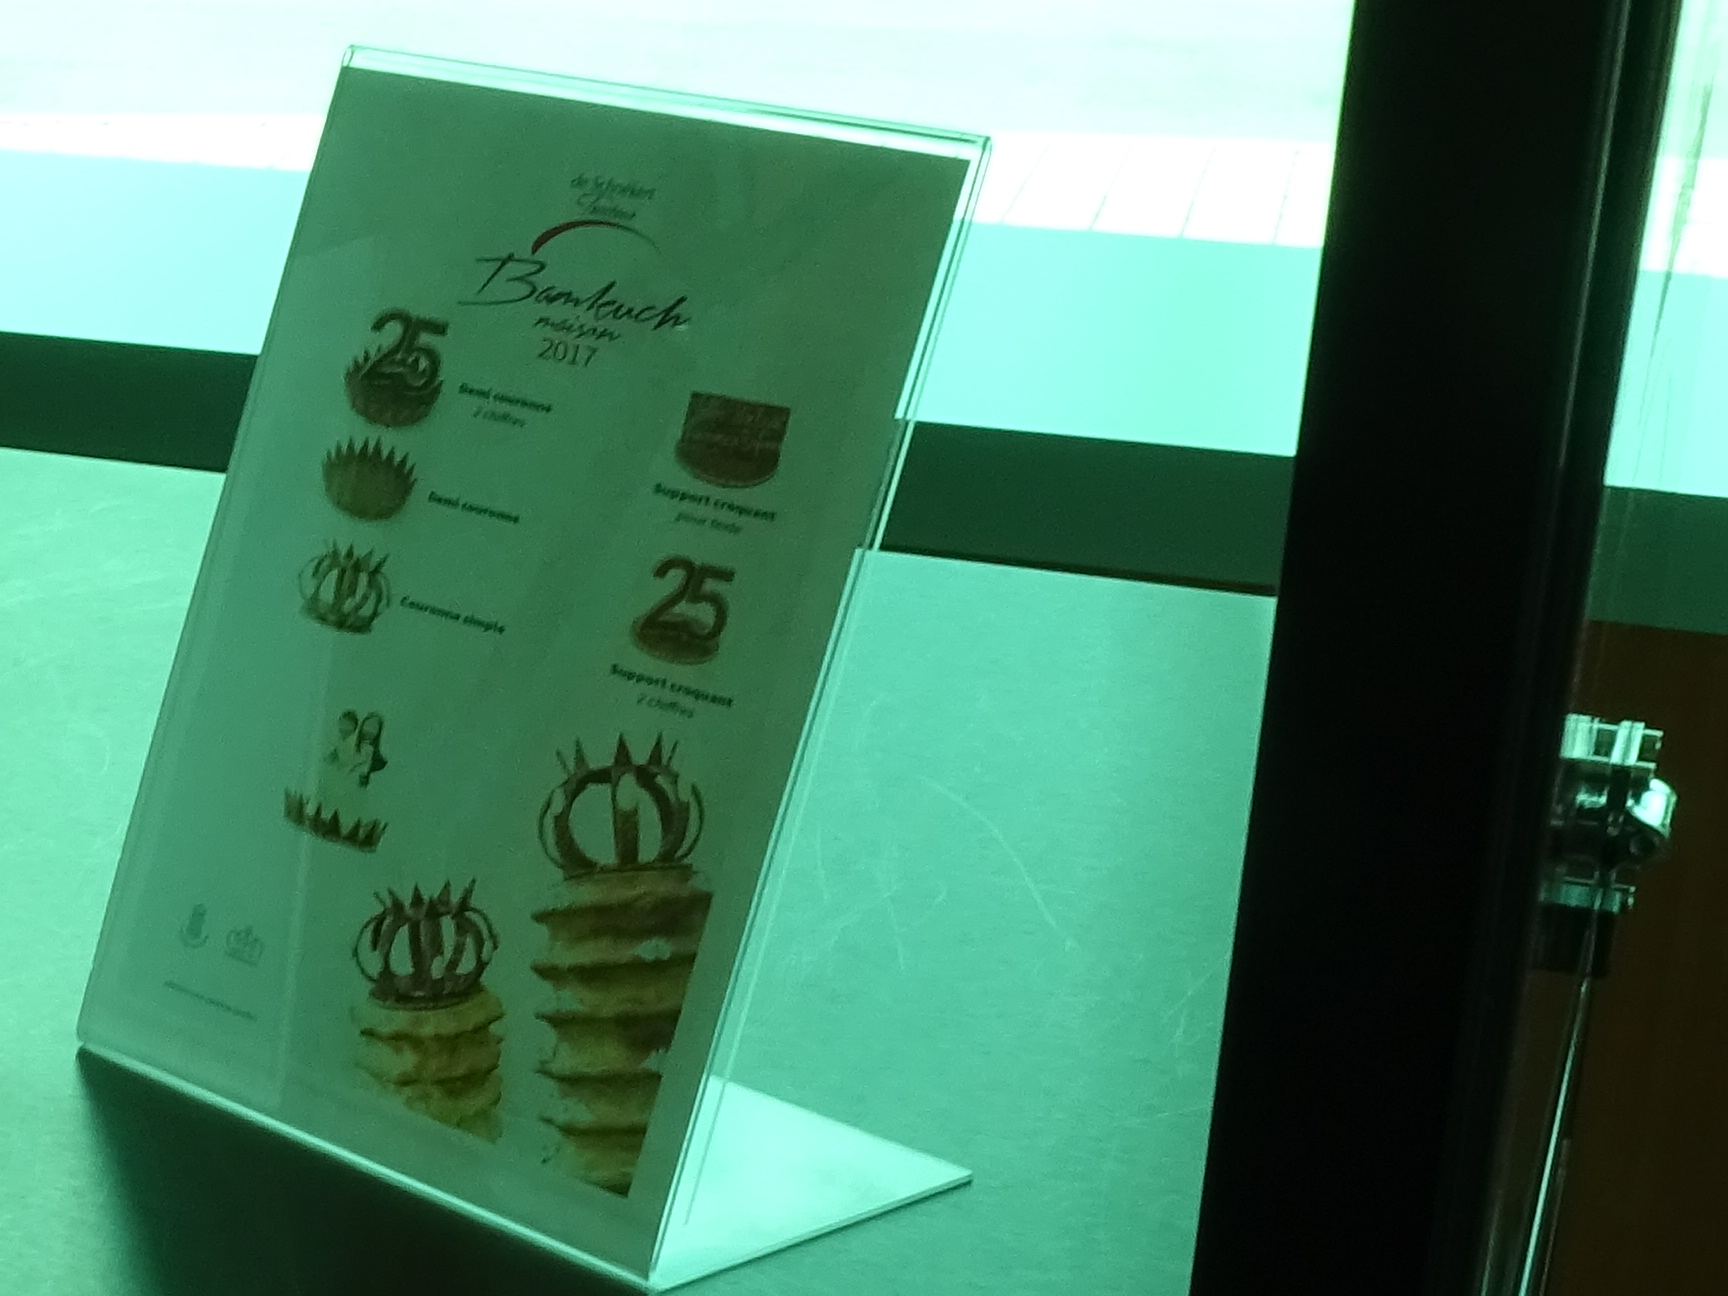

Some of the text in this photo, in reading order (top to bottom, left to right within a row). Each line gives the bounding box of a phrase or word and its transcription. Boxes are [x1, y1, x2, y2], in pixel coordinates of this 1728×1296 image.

[537, 339, 598, 367] 2017
[653, 482, 777, 522] Support croquant
[610, 662, 734, 708] Support croquant
